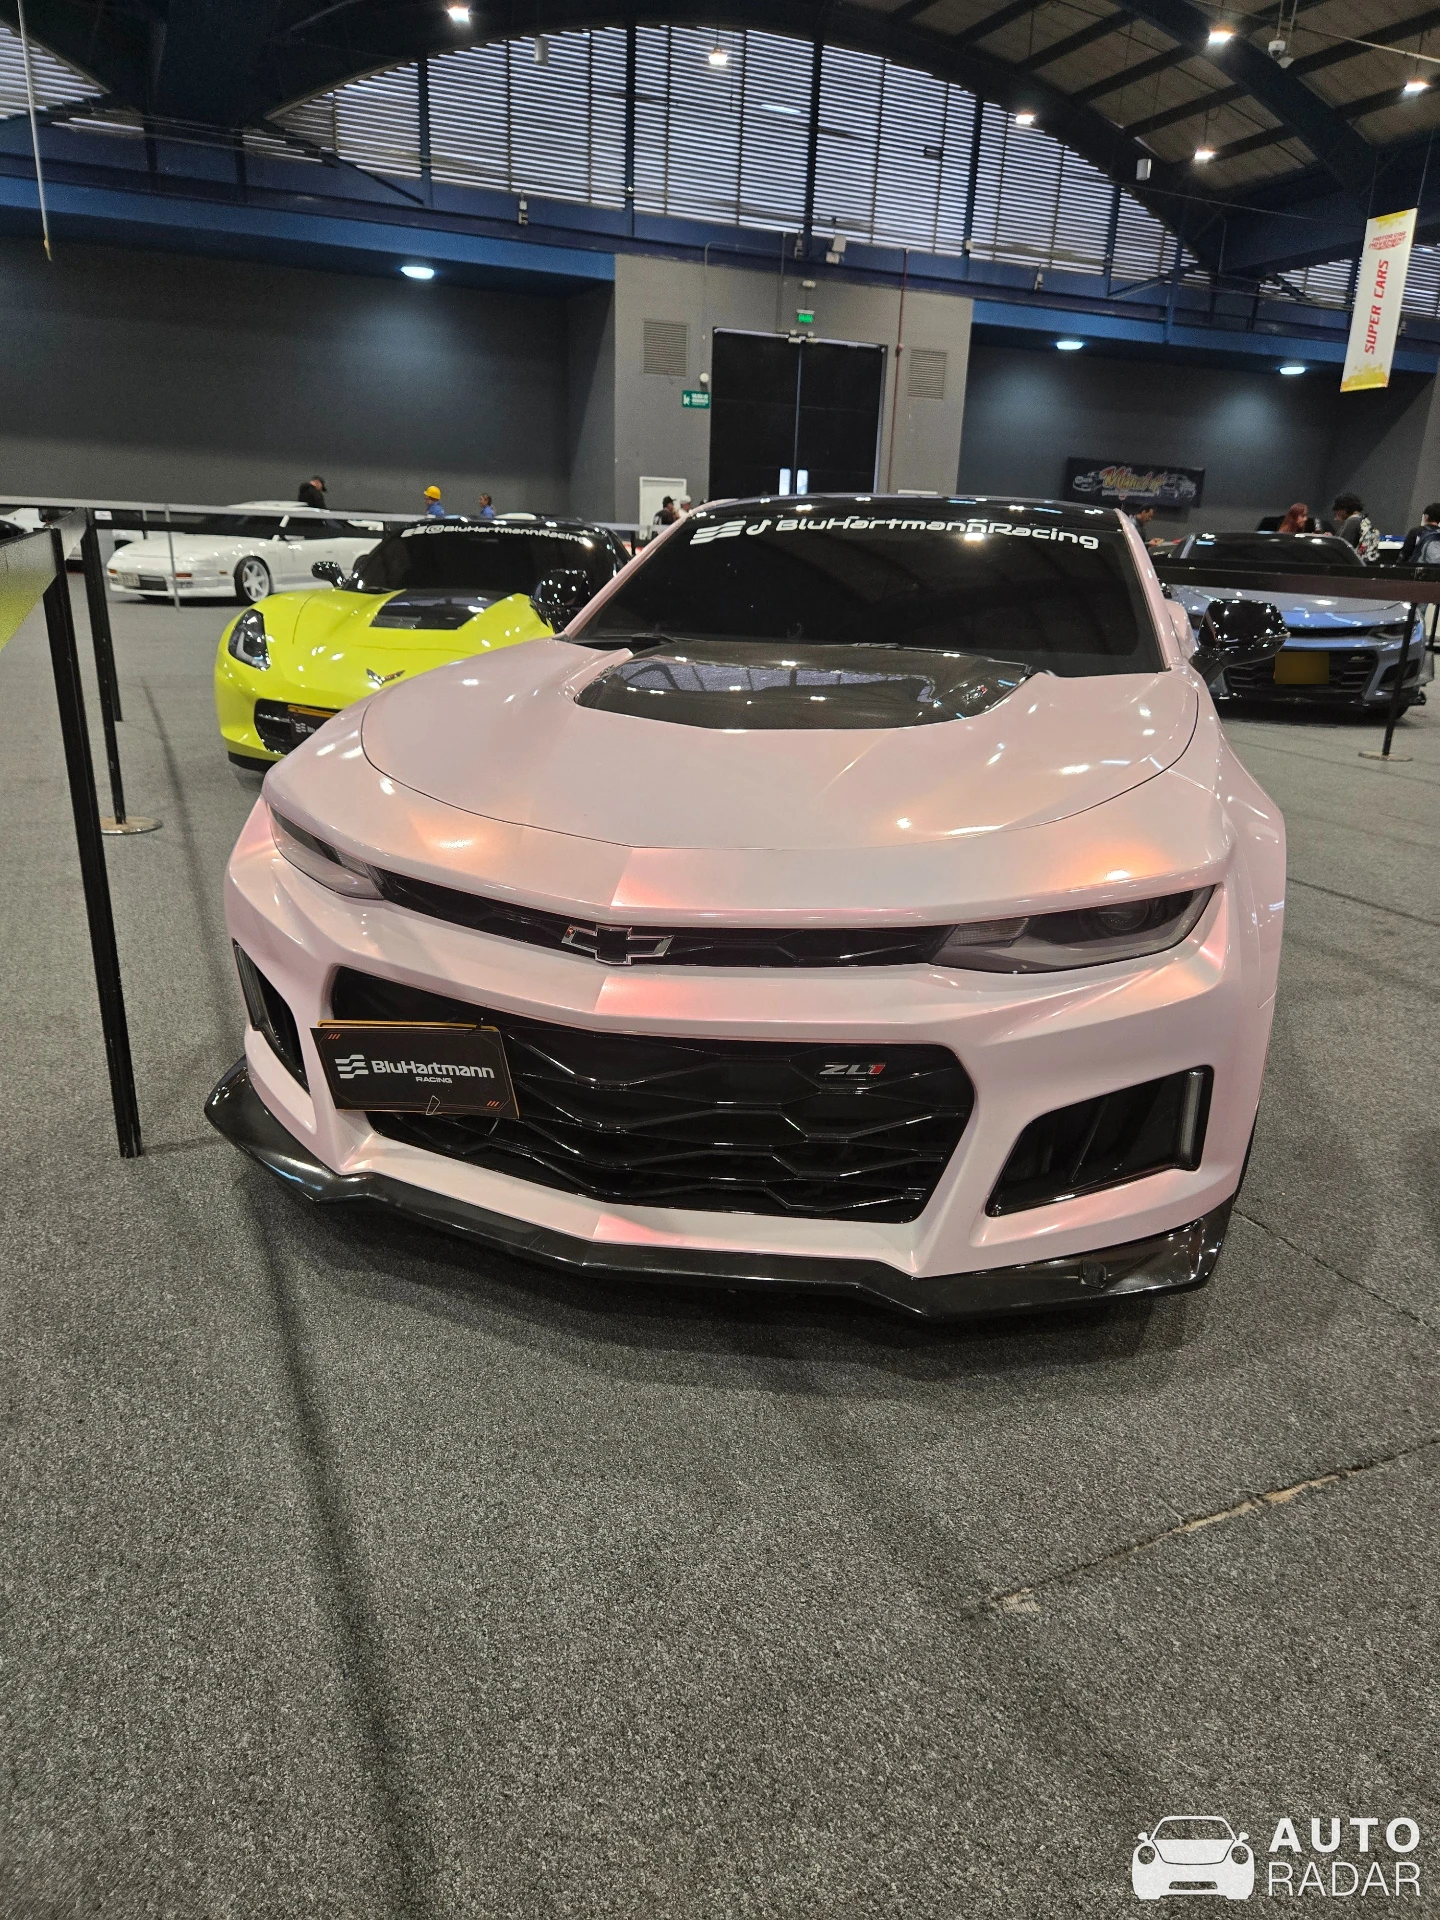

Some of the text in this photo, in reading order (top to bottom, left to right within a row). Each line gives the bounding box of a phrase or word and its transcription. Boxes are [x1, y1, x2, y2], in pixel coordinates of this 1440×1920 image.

[1364, 259, 1389, 355] SUPER CARS
[776, 517, 1099, 549] BluHartmannRacing
[371, 1061, 494, 1078] BluHartmann
[819, 1064, 886, 1075] ZL1
[415, 1076, 453, 1084] RACING
